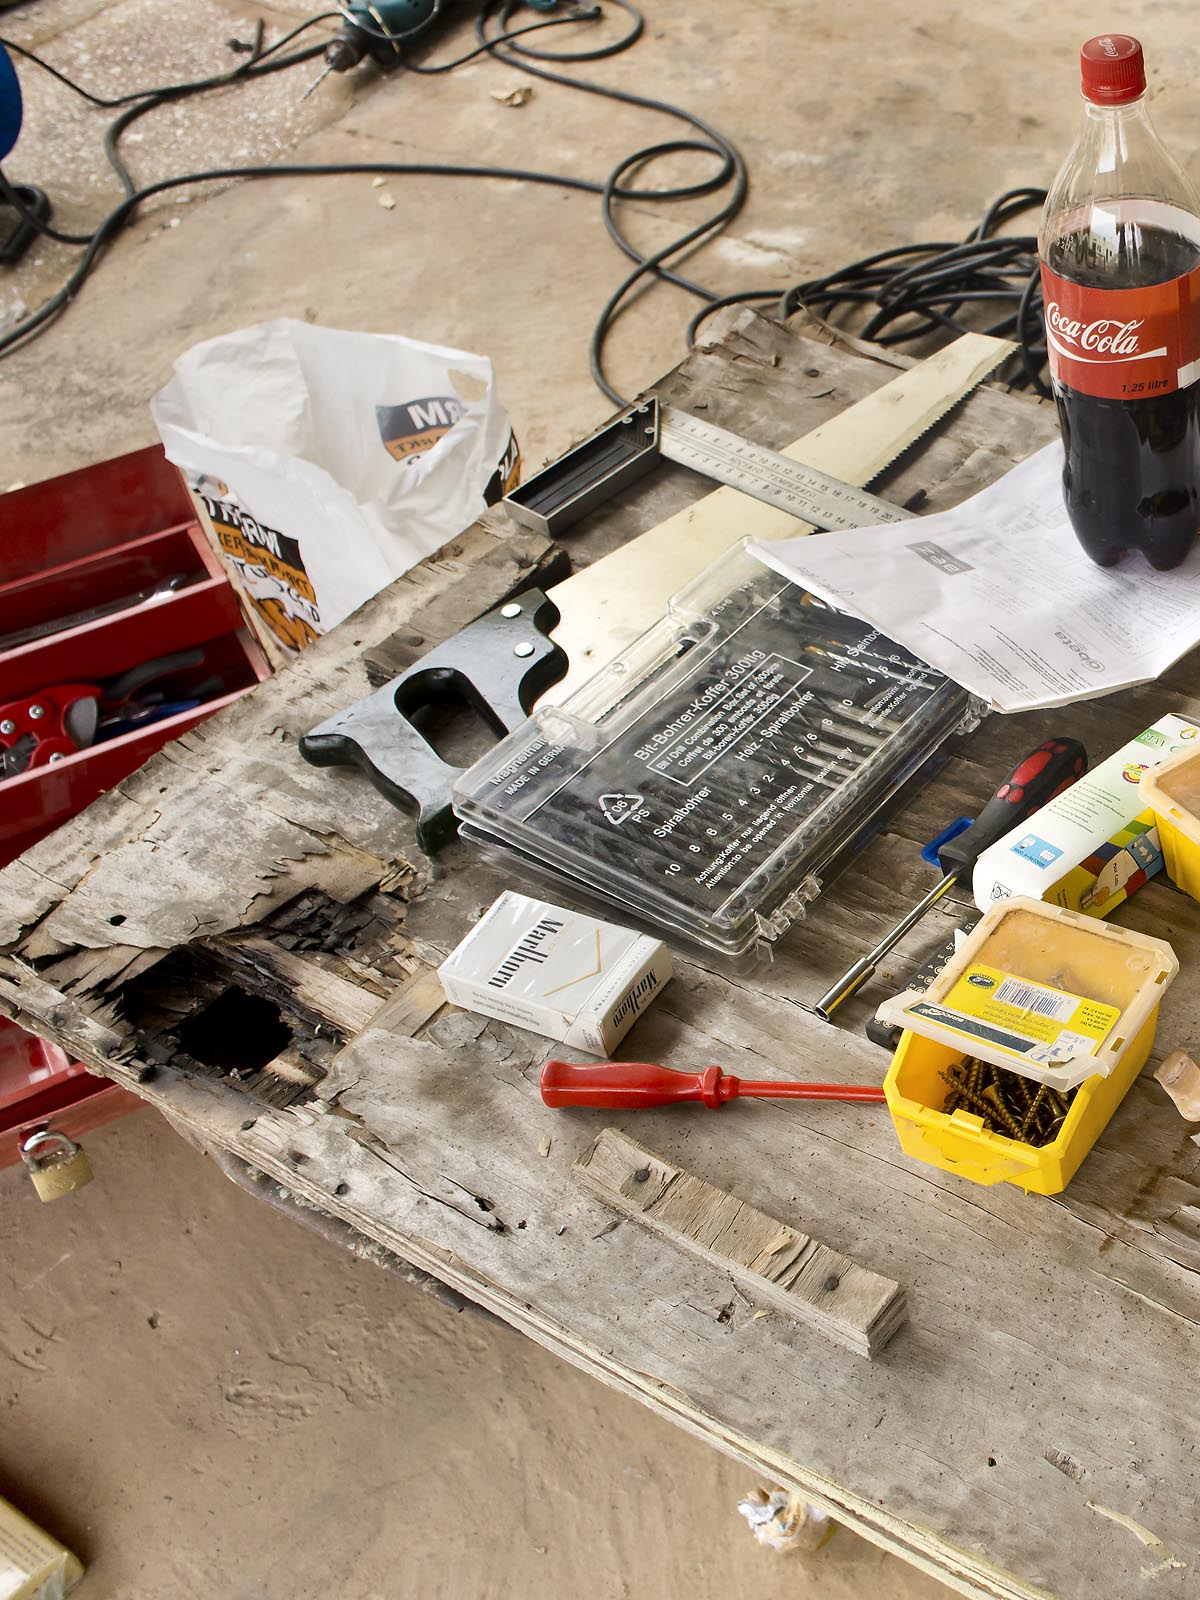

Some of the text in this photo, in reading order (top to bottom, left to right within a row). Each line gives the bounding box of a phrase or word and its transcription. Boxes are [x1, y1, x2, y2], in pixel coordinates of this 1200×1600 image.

[1046, 301, 1144, 355] Coca-Cola
[1122, 379, 1168, 392] 1.25 litre
[881, 512, 893, 520] 20
[866, 677, 876, 685] 4
[634, 679, 730, 761] Bit-Bohrer-Koffer
[685, 711, 725, 745] Combination
[702, 713, 756, 760] Bit-boren-Koffer
[735, 743, 757, 761] Holz
[760, 690, 815, 739] Spiralbohrer
[780, 758, 790, 767] 4
[793, 745, 805, 754] 5
[806, 732, 818, 742] 6
[822, 718, 833, 726] 8
[678, 745, 705, 767] Coffret
[703, 737, 714, 746] de
[711, 723, 728, 736] 300
[504, 774, 530, 796] MADE
[528, 765, 541, 778] IN
[611, 799, 628, 813] 06
[632, 808, 651, 824] PS
[653, 785, 713, 839] Spiralbohrer
[664, 774, 774, 877] 10 8 6 5 4 3 2
[694, 785, 798, 885] Achtung:Koffer nur liegend öffnen
[705, 853, 742, 890] Attention:to
[740, 843, 752, 854] be
[751, 818, 777, 844] opened
[775, 810, 785, 820] in
[784, 782, 815, 812] horizontal
[487, 917, 564, 989] Marlboro
[612, 968, 658, 1028] Marlboro
